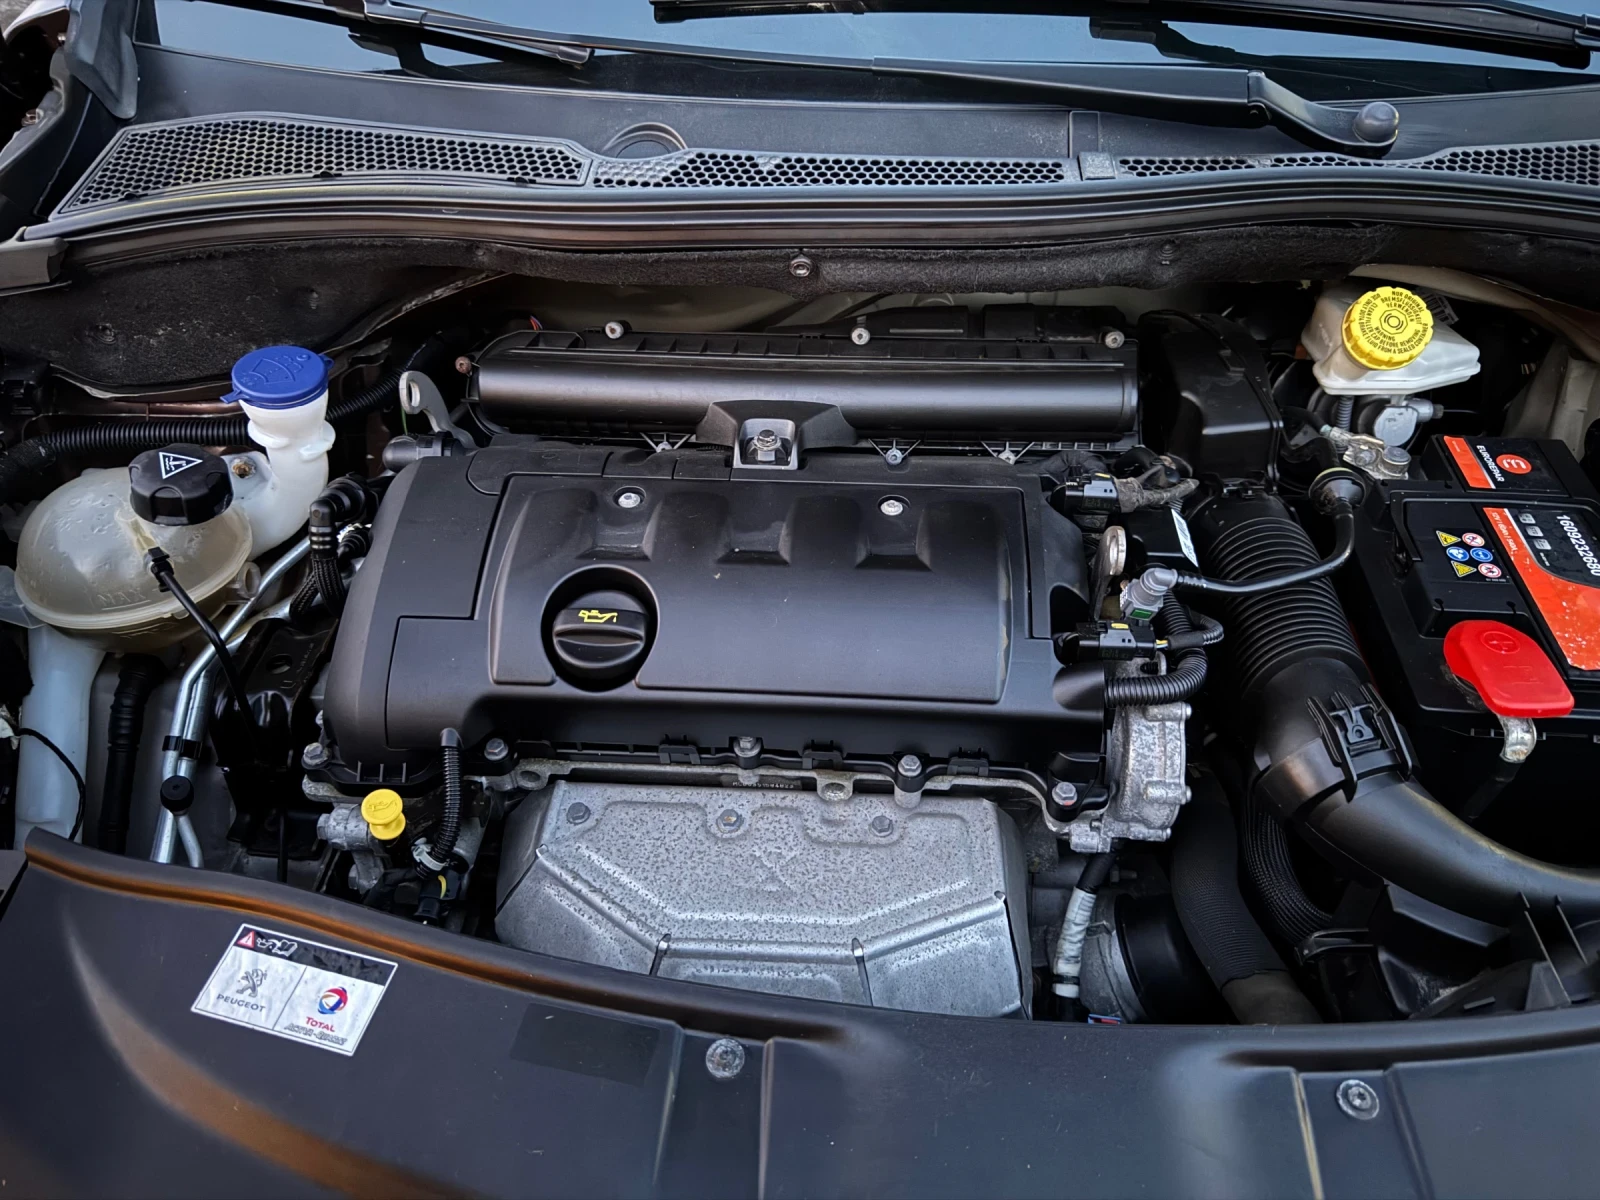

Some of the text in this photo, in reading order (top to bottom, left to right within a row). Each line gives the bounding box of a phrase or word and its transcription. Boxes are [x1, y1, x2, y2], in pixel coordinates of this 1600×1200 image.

[1362, 298, 1372, 310] ONLY
[1386, 302, 1415, 322] VERWENDEN
[1404, 293, 1424, 313] ORIGINAL
[1358, 321, 1368, 337] BRAKE
[1365, 302, 1421, 348] CLEAN FILLER CAP BEFORE REMOVING
[1374, 326, 1396, 342] WARNING
[1365, 336, 1378, 348] FLUID
[1413, 322, 1429, 347] CONTAINER
[1377, 345, 1392, 354] FROM
[1397, 343, 1416, 355] SEALED
[1476, 445, 1505, 482] EUROREPAR
[1557, 514, 1600, 577] 1609232680
[216, 993, 266, 1013] PEUGEOT
[306, 1016, 335, 1033] TOTAL
